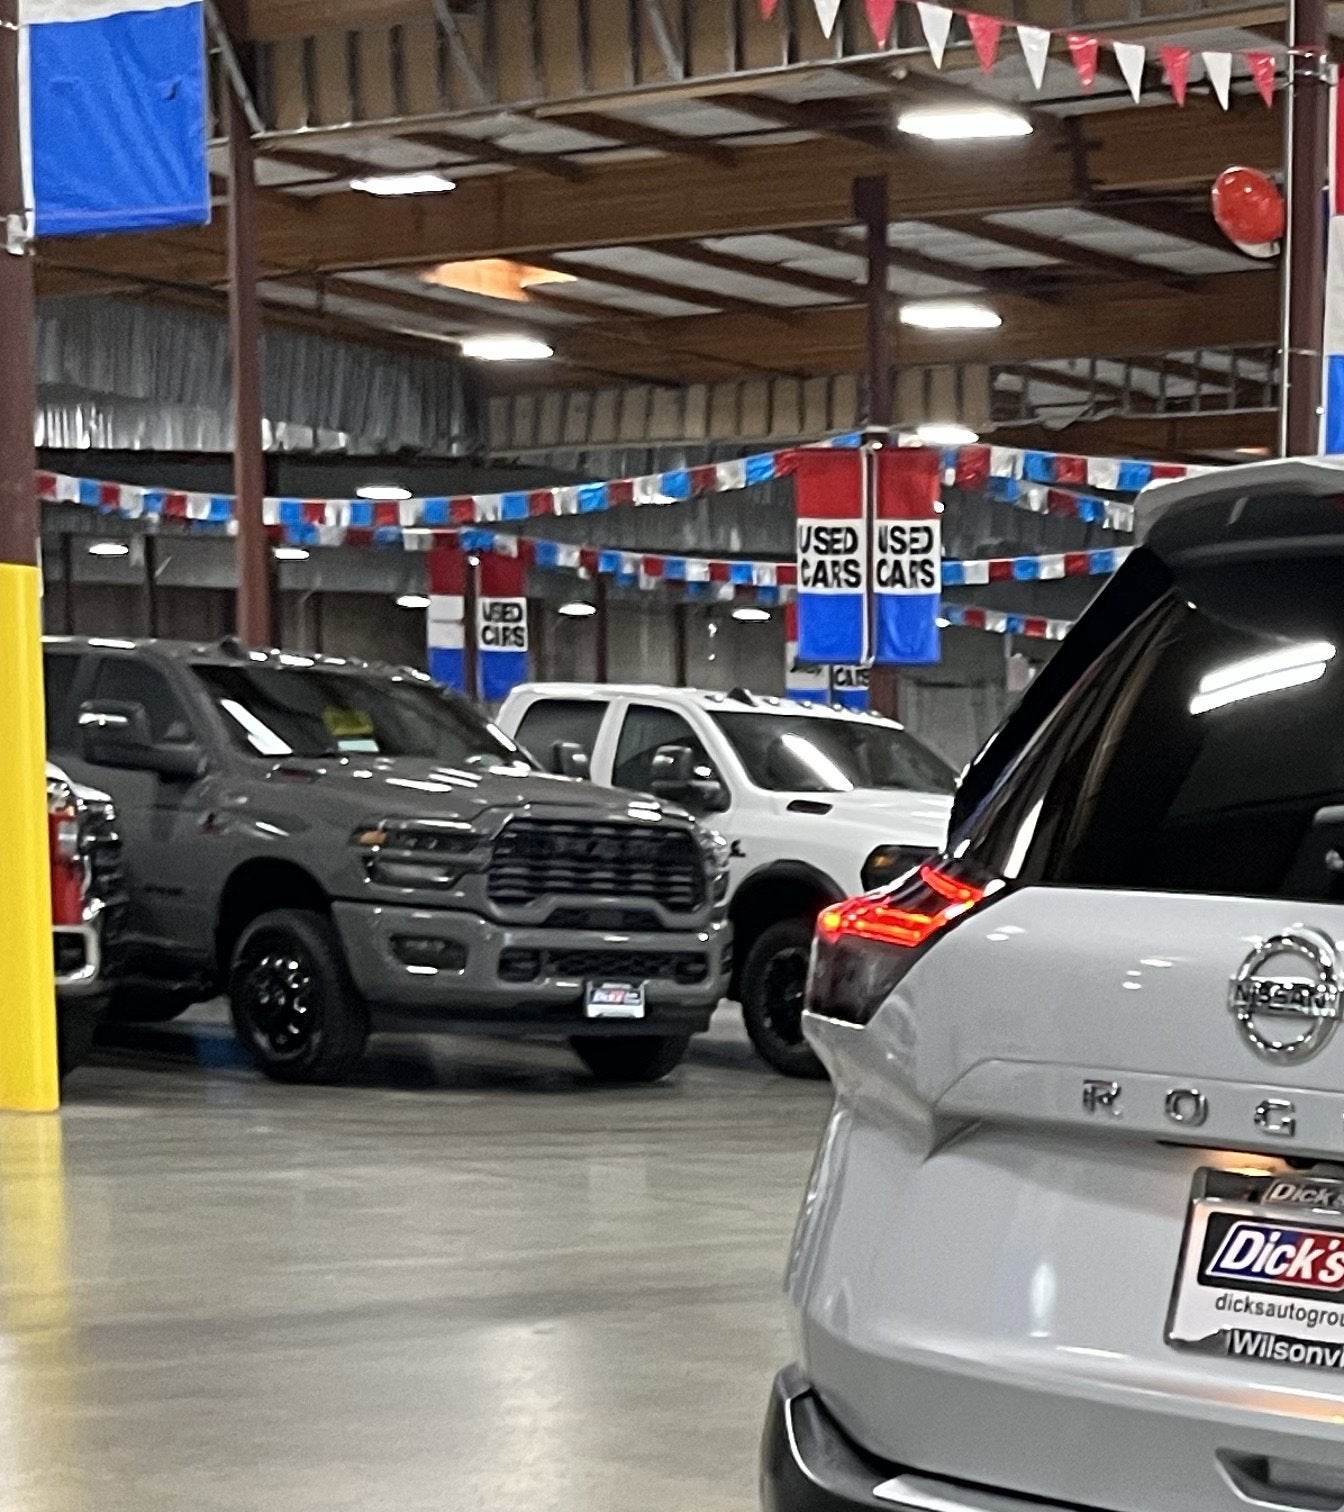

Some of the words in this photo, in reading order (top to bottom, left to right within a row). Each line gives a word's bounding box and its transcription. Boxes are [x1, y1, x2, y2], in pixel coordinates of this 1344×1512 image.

[799, 526, 858, 555] USED
[878, 526, 933, 555] USED
[800, 559, 862, 588] CARS
[876, 558, 934, 588] CARS
